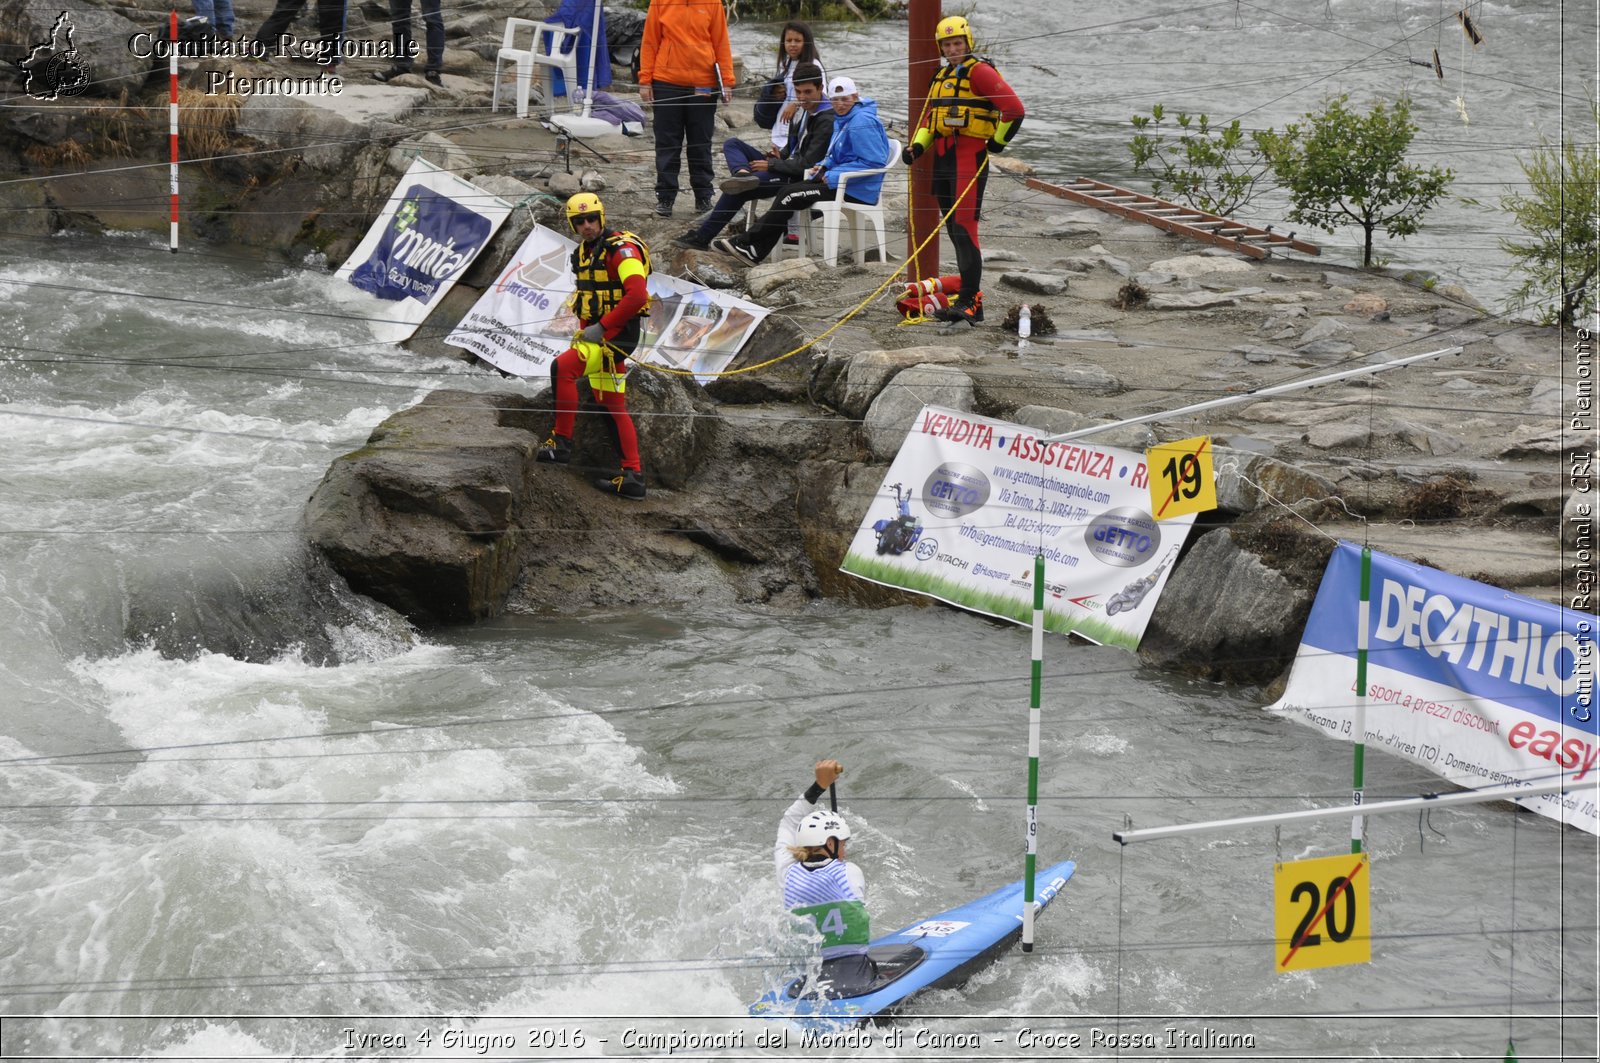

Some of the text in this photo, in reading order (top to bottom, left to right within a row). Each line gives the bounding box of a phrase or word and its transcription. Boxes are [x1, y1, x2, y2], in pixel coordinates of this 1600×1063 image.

[922, 411, 993, 450] VENDITA
[1008, 433, 1114, 480] ASSISTENZA
[930, 480, 978, 506] GETTO
[993, 465, 1110, 504] www.gettomacchineagricole.com
[1163, 453, 1201, 502] 19
[998, 488, 1009, 503] Via
[1010, 491, 1034, 513] Torino,
[1035, 498, 1047, 513] 26
[1049, 501, 1073, 518] IVREA
[1003, 513, 1017, 528] Tel.
[917, 543, 936, 557] BCS
[936, 553, 970, 570] HITACHI
[1093, 526, 1150, 553] GETTO
[1369, 684, 1402, 704] sport
[1402, 695, 1412, 707] a
[1412, 698, 1454, 720] prezzi
[1453, 708, 1500, 736] discount
[1304, 708, 1338, 730] Toscana
[1385, 733, 1416, 755] d'Ivrea
[1445, 752, 1489, 778] Domenica
[1489, 771, 1522, 788] sempre
[1290, 876, 1356, 949] 20
